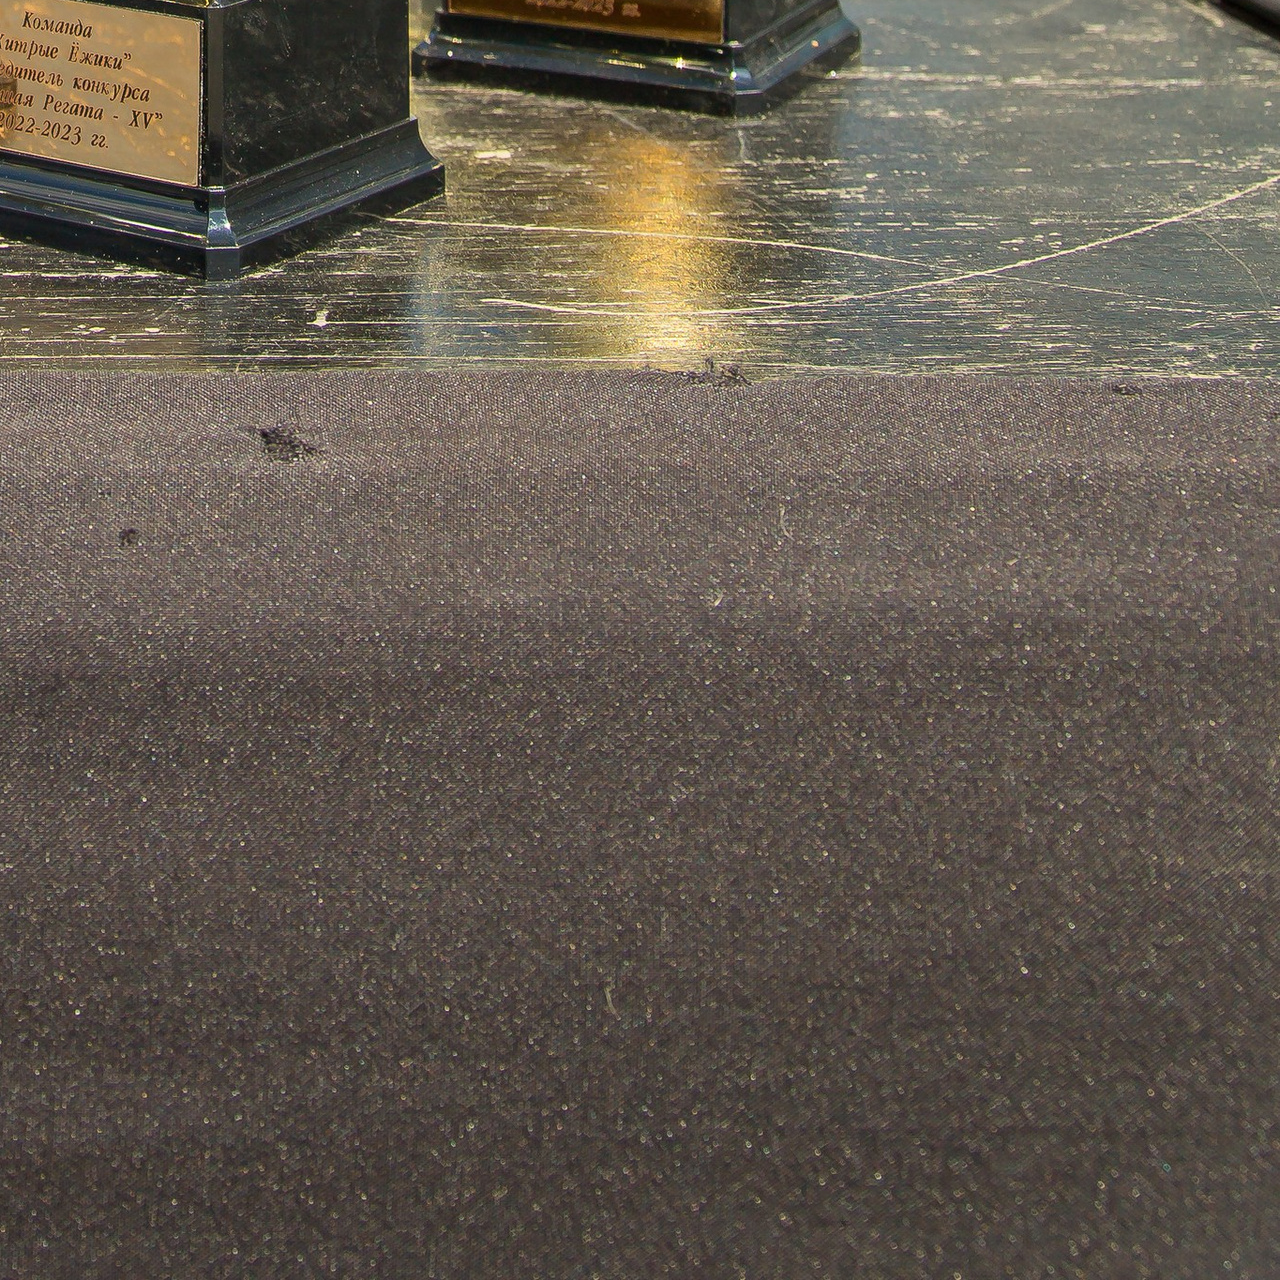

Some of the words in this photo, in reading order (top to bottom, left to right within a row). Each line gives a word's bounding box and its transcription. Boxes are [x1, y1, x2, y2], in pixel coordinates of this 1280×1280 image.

[22, 11, 93, 39] Команда
[67, 42, 132, 70] Ёжики”
[72, 75, 150, 103] конкурса
[43, 94, 104, 120] Регата
[128, 110, 163, 129] XV”
[91, 134, 109, 149] гг.
